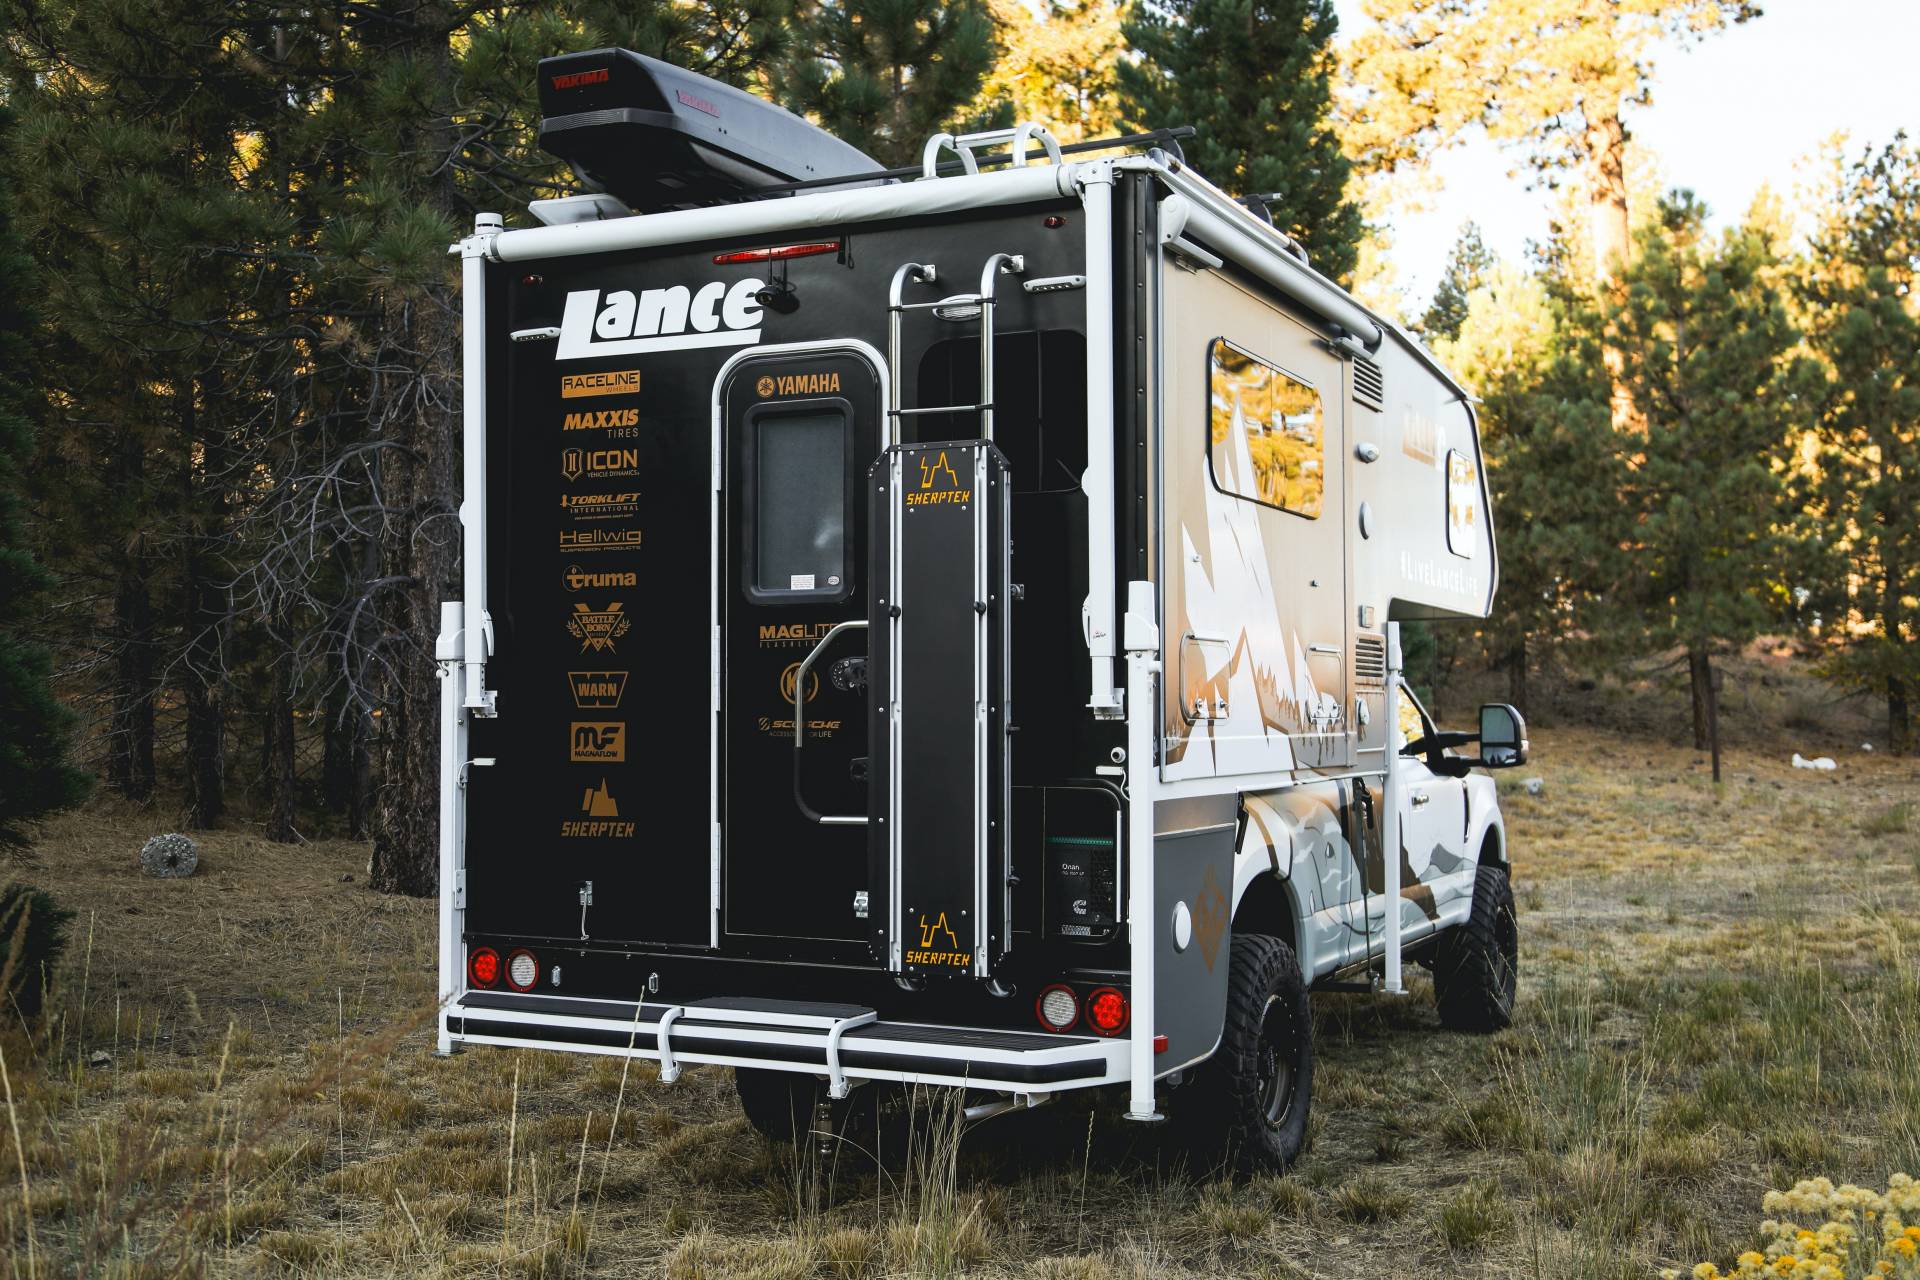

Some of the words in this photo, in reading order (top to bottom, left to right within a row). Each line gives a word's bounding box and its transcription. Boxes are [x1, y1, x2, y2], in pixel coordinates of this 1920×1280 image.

[552, 68, 609, 91] YAKIMA
[555, 278, 765, 361] Lance
[563, 372, 639, 391] RACELINE
[777, 372, 840, 396] YAMAHA
[563, 408, 640, 431] MAXXIS
[607, 427, 639, 439] TIRES
[586, 448, 638, 471] ICON
[571, 492, 641, 505] TORKLIFT
[906, 490, 971, 505] SHERPTEK
[570, 505, 639, 514] INTERNATIONAL
[560, 528, 641, 544] Hellwig
[566, 567, 637, 589] truma
[581, 615, 616, 624] BATTLE
[586, 623, 611, 632] BORN
[578, 682, 617, 697] WARN
[574, 750, 618, 758] MAGNAFLOW
[560, 821, 636, 837] SHERPTEK
[905, 950, 971, 966] SHERPTEK
